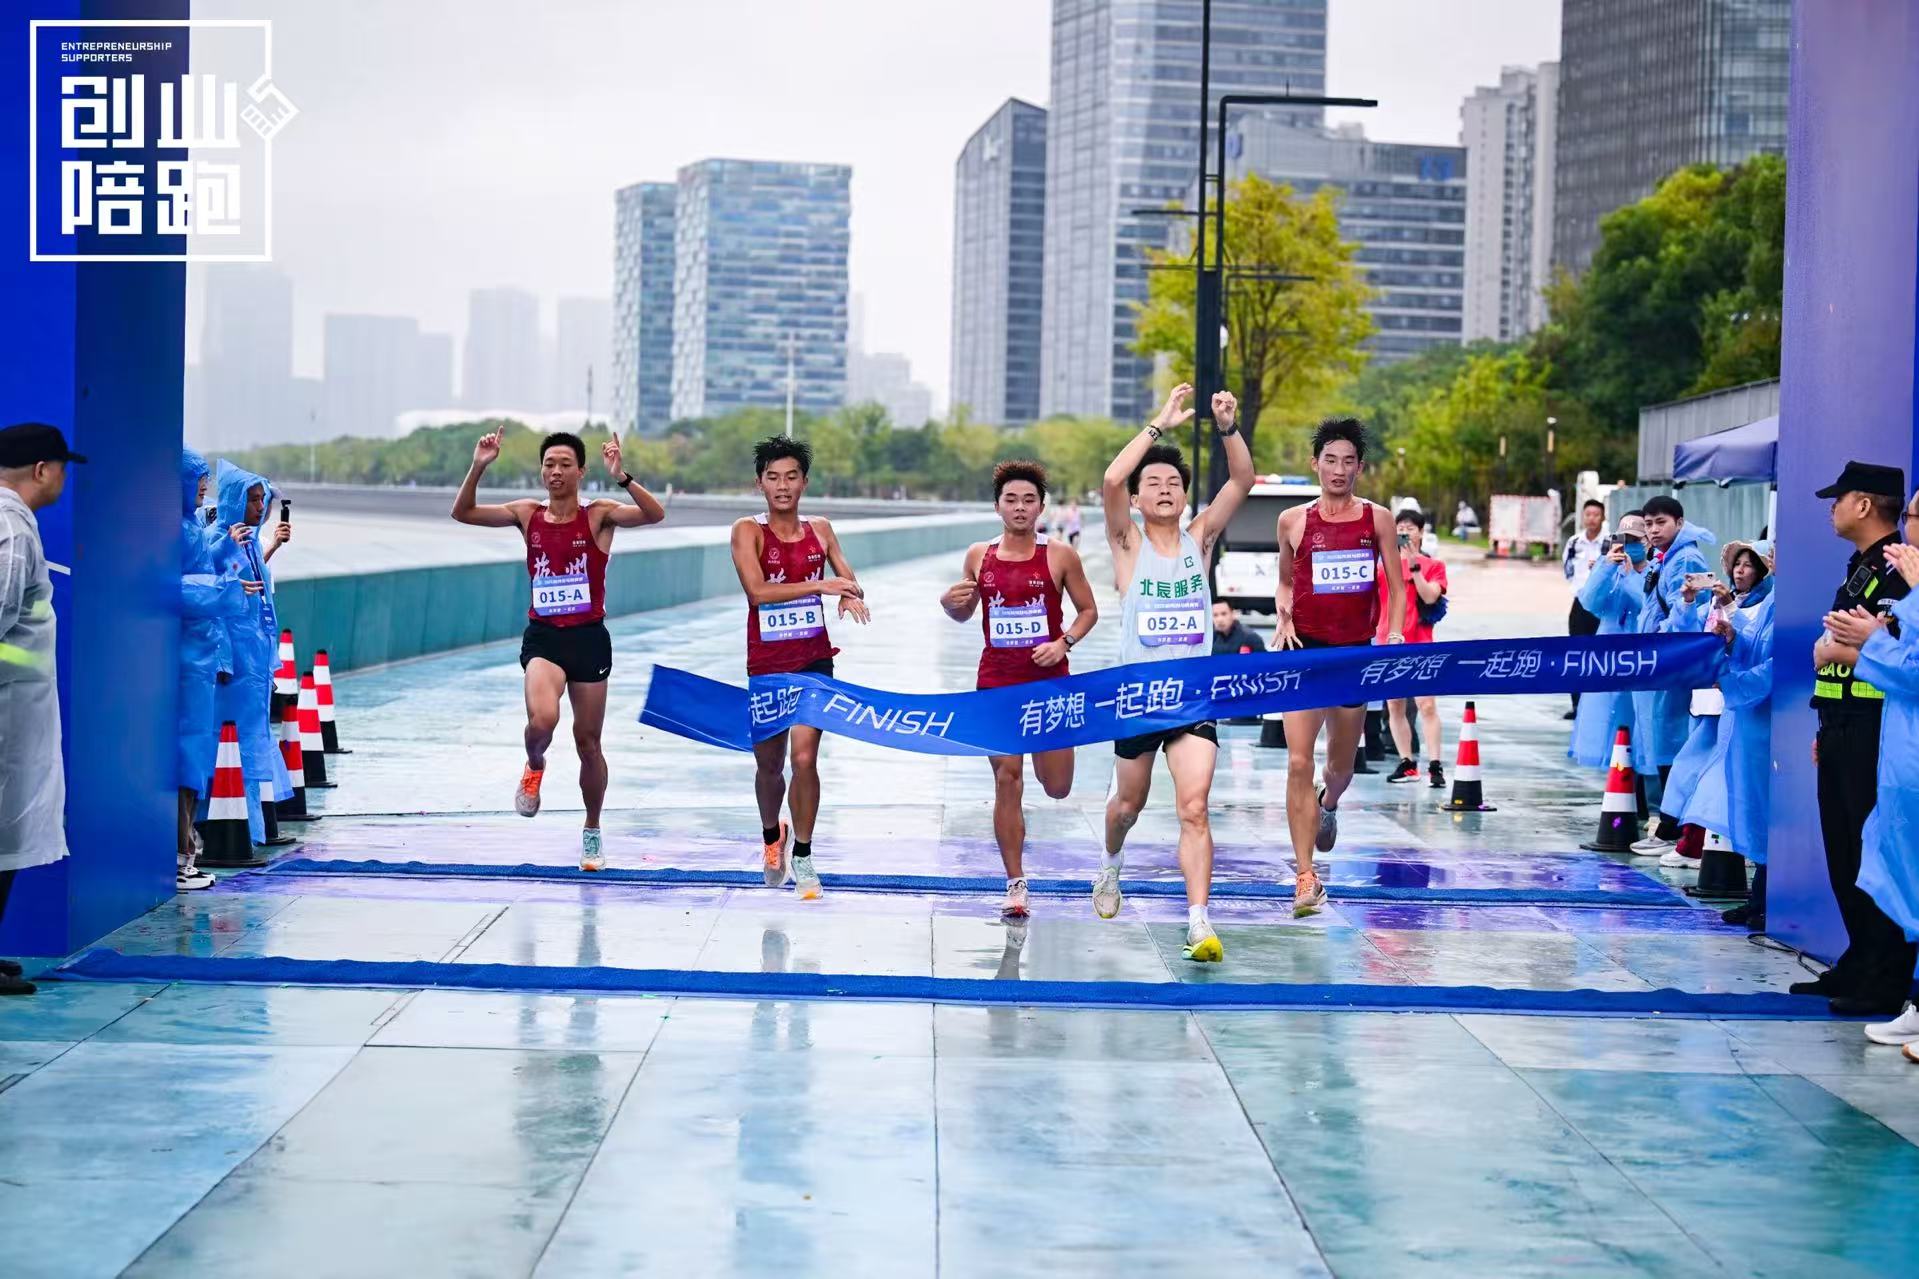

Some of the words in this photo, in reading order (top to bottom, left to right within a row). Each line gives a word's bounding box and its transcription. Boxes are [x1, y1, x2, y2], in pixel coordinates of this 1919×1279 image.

[1321, 565, 1368, 580] 015-C
[1139, 573, 1203, 598] 北辰服务
[540, 588, 583, 604] 015-A
[767, 611, 816, 628] 015-B
[1147, 616, 1198, 631] 052-A
[996, 621, 1041, 635] 015-D
[823, 694, 955, 737] FINISH
[1019, 691, 1086, 737] 有梦想
[1095, 677, 1184, 721] 一起跑
[1211, 668, 1311, 700] FINISH
[1360, 653, 1450, 686] 有梦想
[1458, 648, 1543, 679] 一起跑
[1561, 649, 1658, 677] FINISH
